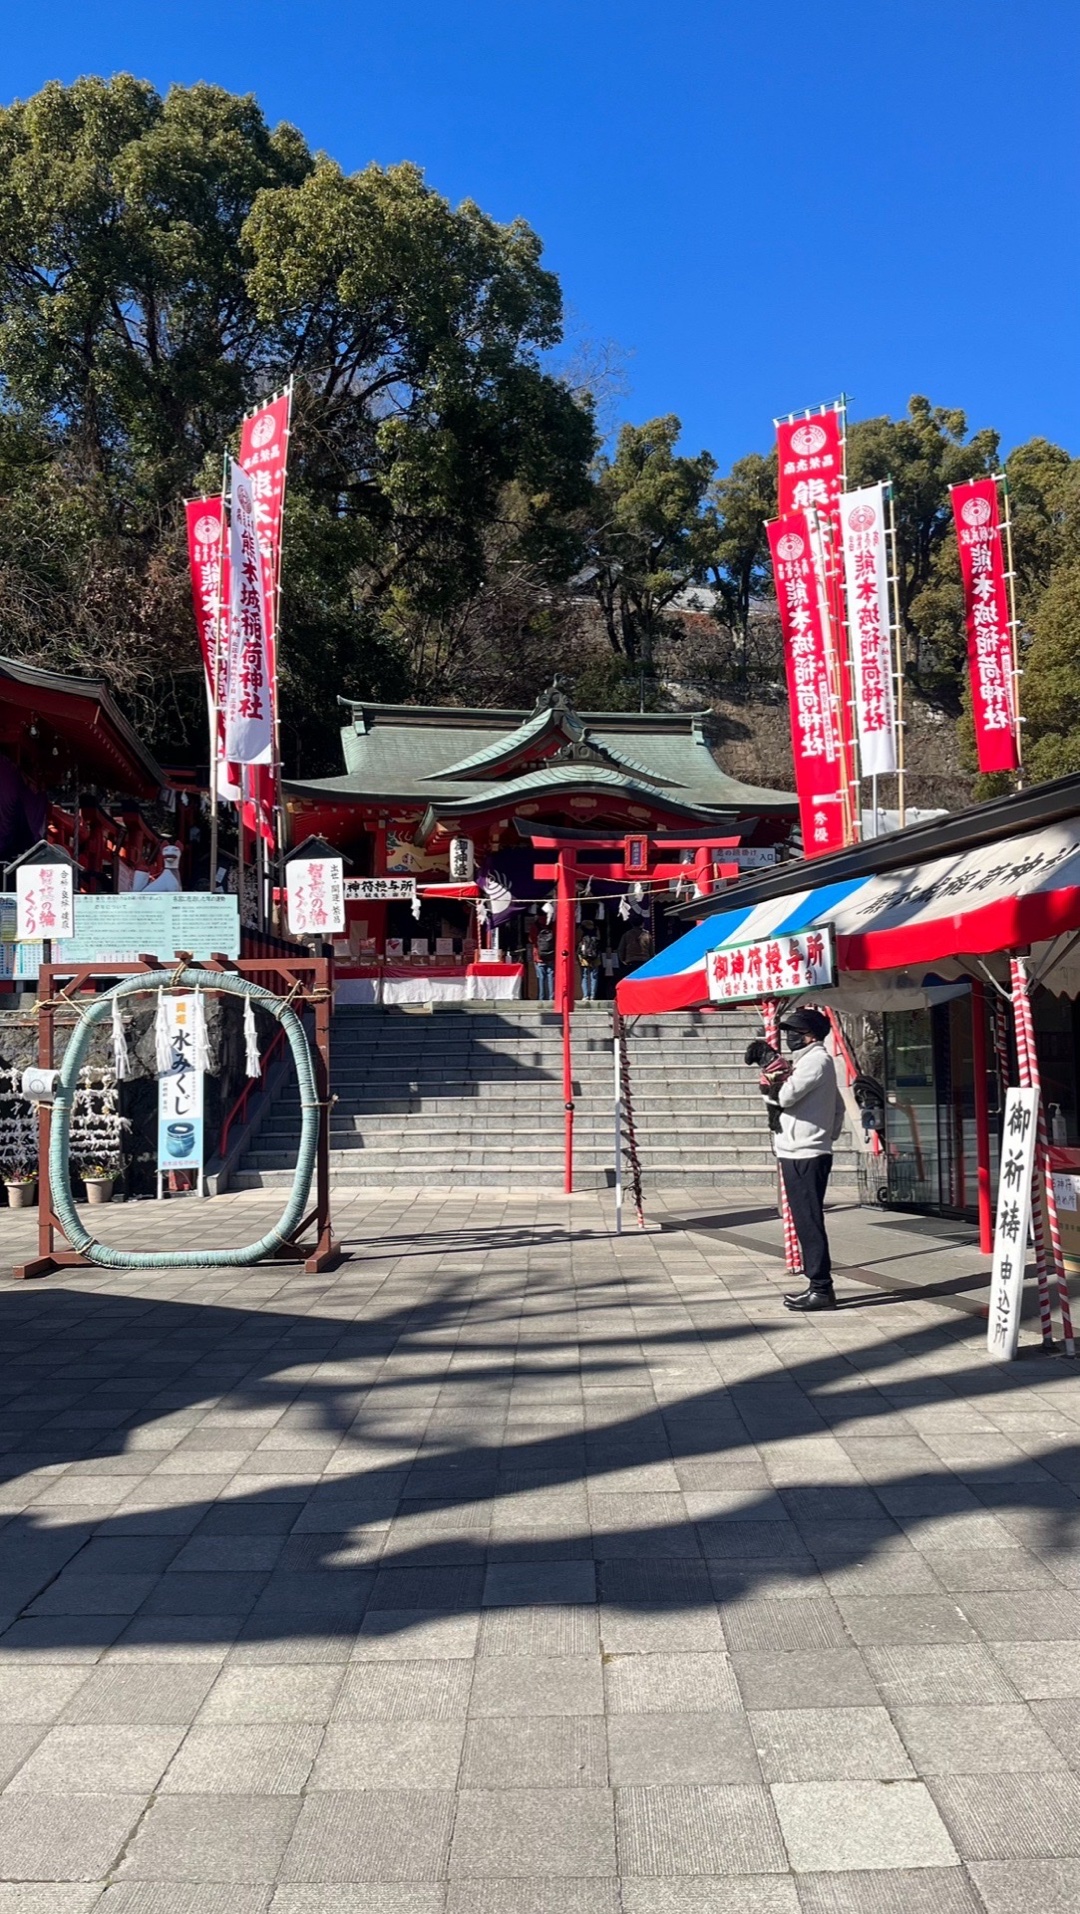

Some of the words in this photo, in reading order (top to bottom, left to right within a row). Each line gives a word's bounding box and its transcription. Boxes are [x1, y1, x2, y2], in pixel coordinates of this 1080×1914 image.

[239, 530, 264, 720] 熊本城稲荷神社
[760, 853, 774, 863] 入口
[344, 880, 414, 892] 神符授与所
[25, 890, 37, 934] くぐり
[713, 933, 825, 984] 御神符授与所
[171, 1028, 194, 1116] 水みくじ
